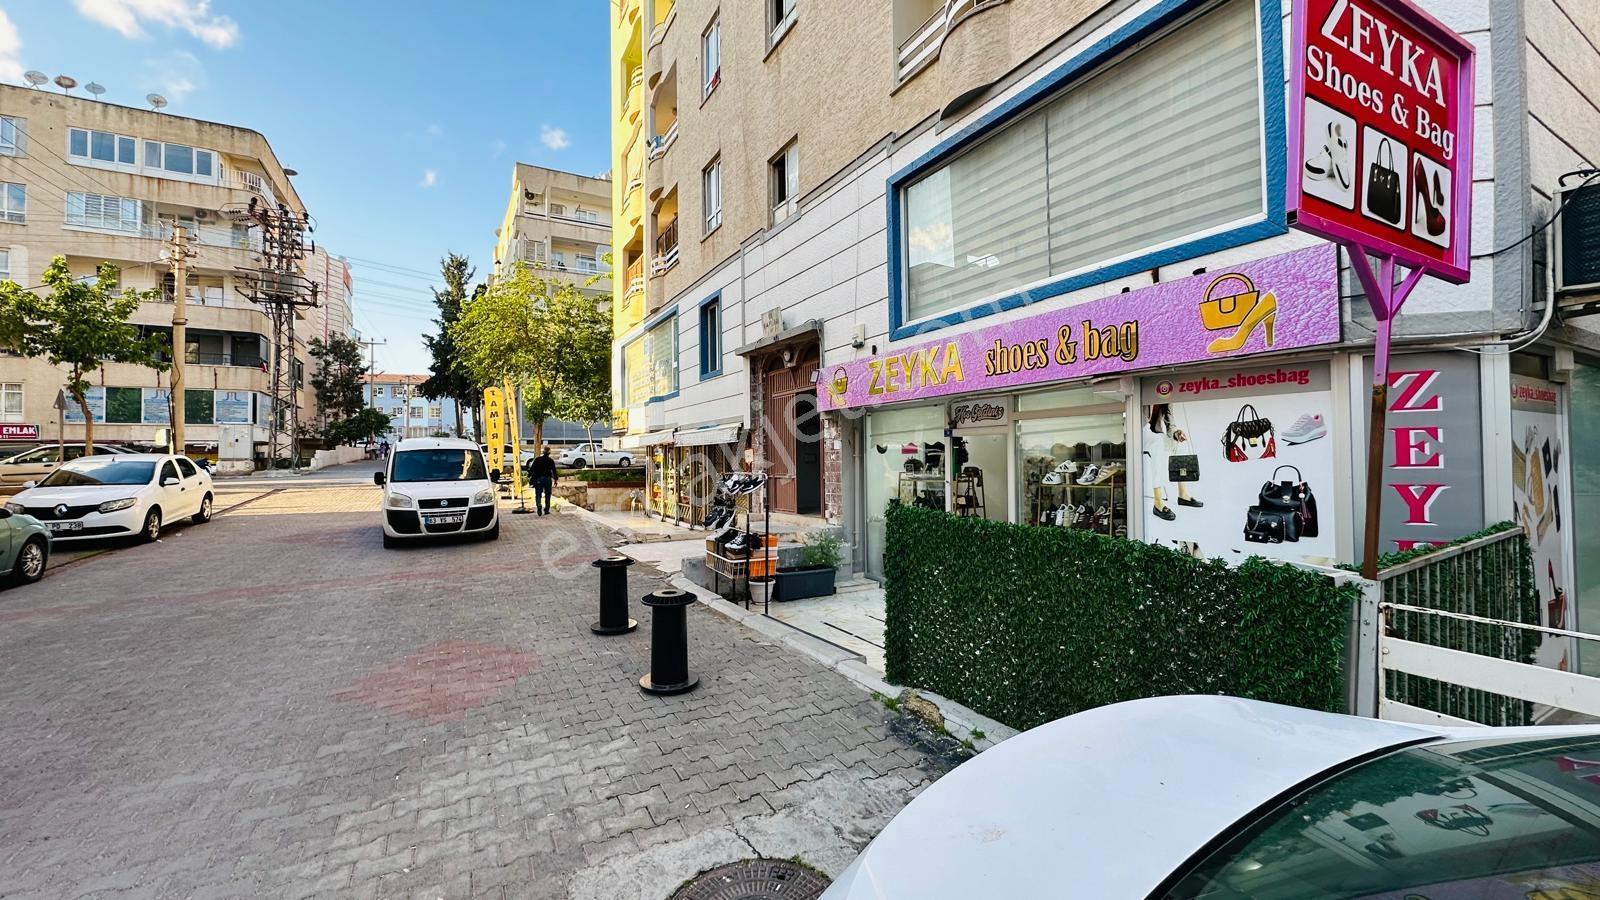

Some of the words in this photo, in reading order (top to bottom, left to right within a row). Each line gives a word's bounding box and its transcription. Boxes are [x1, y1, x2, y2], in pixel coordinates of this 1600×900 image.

[1321, 0, 1446, 107] ZEYKA
[1306, 44, 1383, 114] Shoes
[1391, 93, 1409, 129] &
[1415, 105, 1455, 160] Bag
[868, 341, 965, 396] ZEYKA
[984, 337, 1049, 377] shoes
[1054, 324, 1079, 365] &
[1081, 319, 1139, 362] bag
[1178, 367, 1310, 394] zeyka_shoesbag
[3, 426, 36, 434] EMLAK
